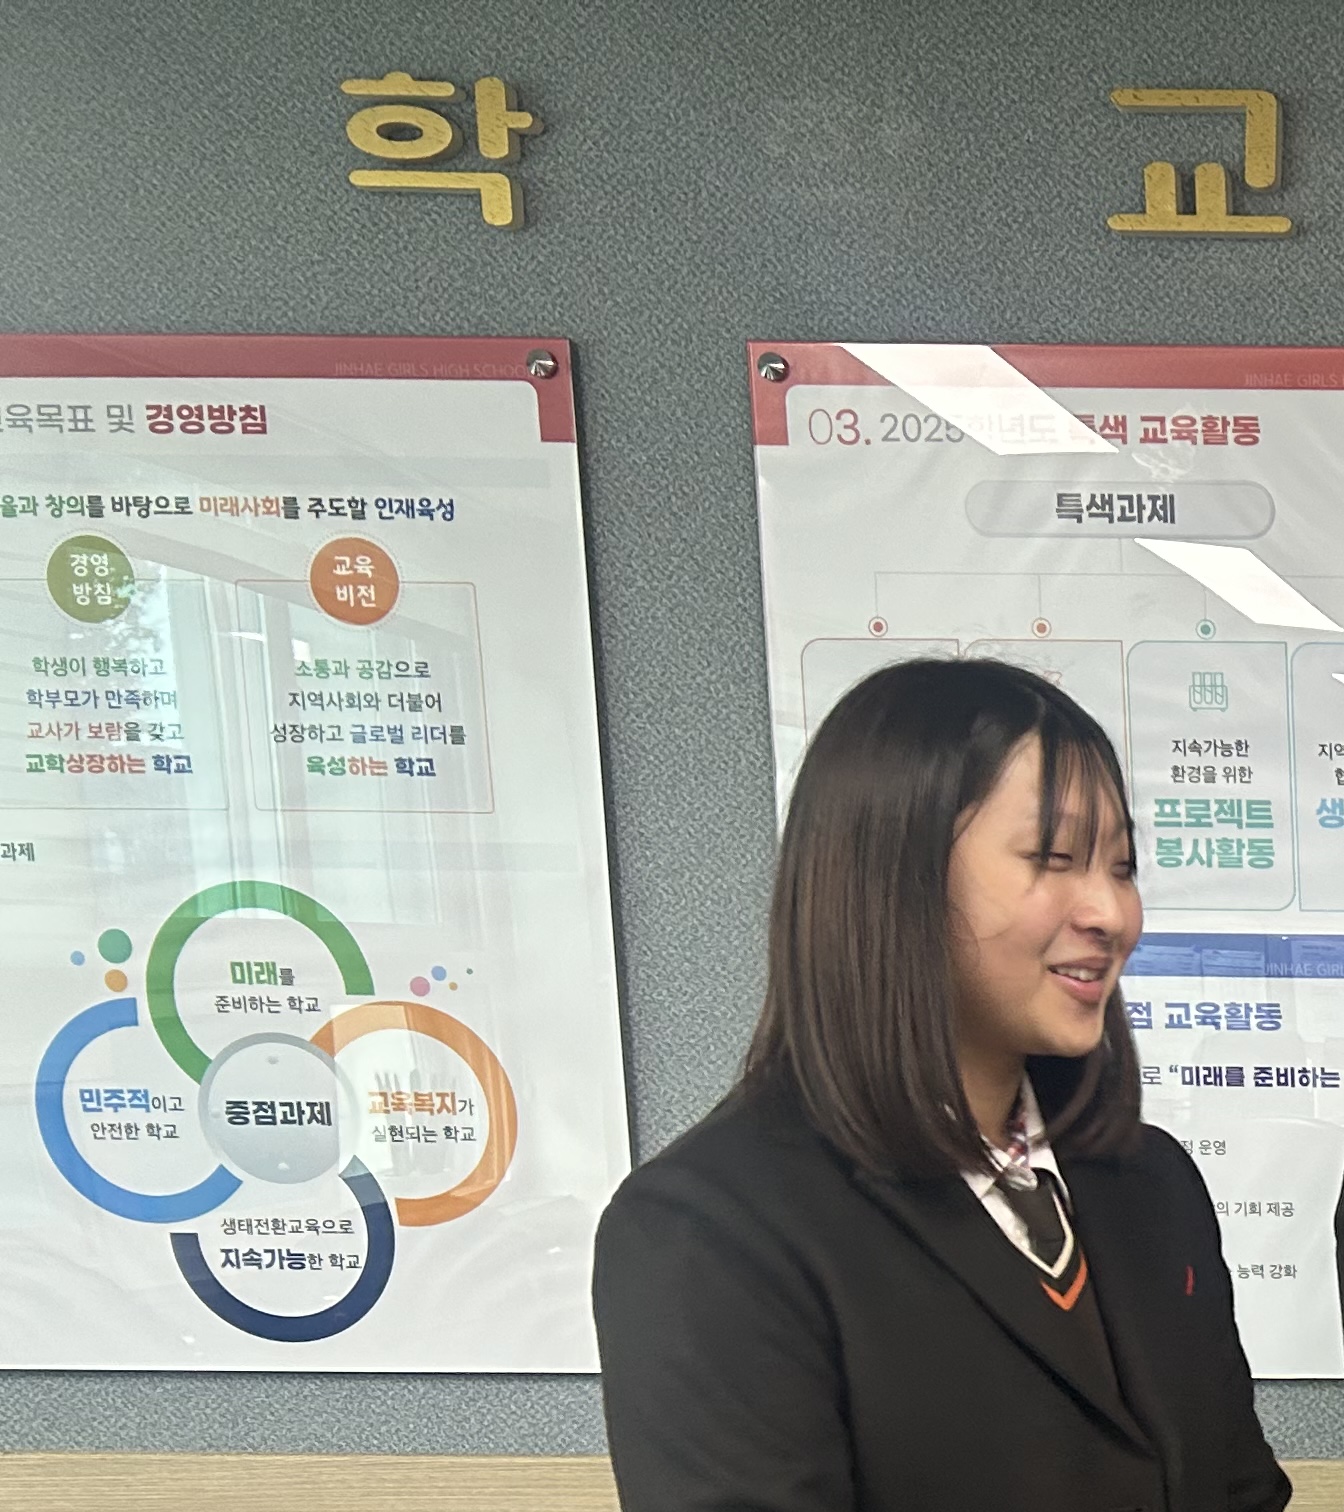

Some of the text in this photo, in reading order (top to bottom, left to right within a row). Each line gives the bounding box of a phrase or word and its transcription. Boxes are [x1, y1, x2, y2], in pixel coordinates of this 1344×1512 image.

[341, 72, 546, 228] 학
[1108, 87, 1292, 238] 교
[0, 404, 267, 434] 육목표 및 경영방침
[809, 409, 871, 445] 03.
[1140, 415, 1260, 446] 교육활동
[46, 494, 454, 521] 창의를 바탕으로 미래사회를 주도할 인재육성
[1056, 493, 1175, 524] 특색과제
[70, 553, 108, 576] 경영
[333, 556, 374, 578] 교육
[73, 583, 111, 605] 방침
[336, 585, 376, 607] 비전
[32, 657, 164, 677] 학생이 행복하고
[294, 659, 431, 680] 소통과 공감으로
[27, 689, 176, 710] 학부모가 만족하며
[288, 691, 442, 712] 지역사회와 더불어
[27, 721, 184, 742] 교사가 보람을 갖고
[271, 723, 466, 745] 성장하고 글로벌 리더를
[1172, 739, 1249, 757] 지속가능한
[26, 754, 193, 774] 교학상장하는 학교
[307, 756, 436, 777] 육성하는 학교
[1171, 765, 1253, 783] 환경을 위한
[1154, 799, 1274, 829] 프로젝트
[1156, 837, 1275, 869] 봉사활동
[230, 961, 295, 986] 미래를
[215, 996, 321, 1014] 준비하는 학교
[1165, 1002, 1282, 1031] 교육활동
[1254, 1067, 1340, 1087] 준비하는
[79, 1089, 185, 1113] 민주적이고
[225, 1101, 332, 1126] 중점과제
[91, 1123, 179, 1140] 안전한 학교
[374, 1125, 476, 1143] 실현되는 학교
[221, 1218, 354, 1235] 생태전환교육으로
[220, 1248, 361, 1270] 지속가능한 학교
